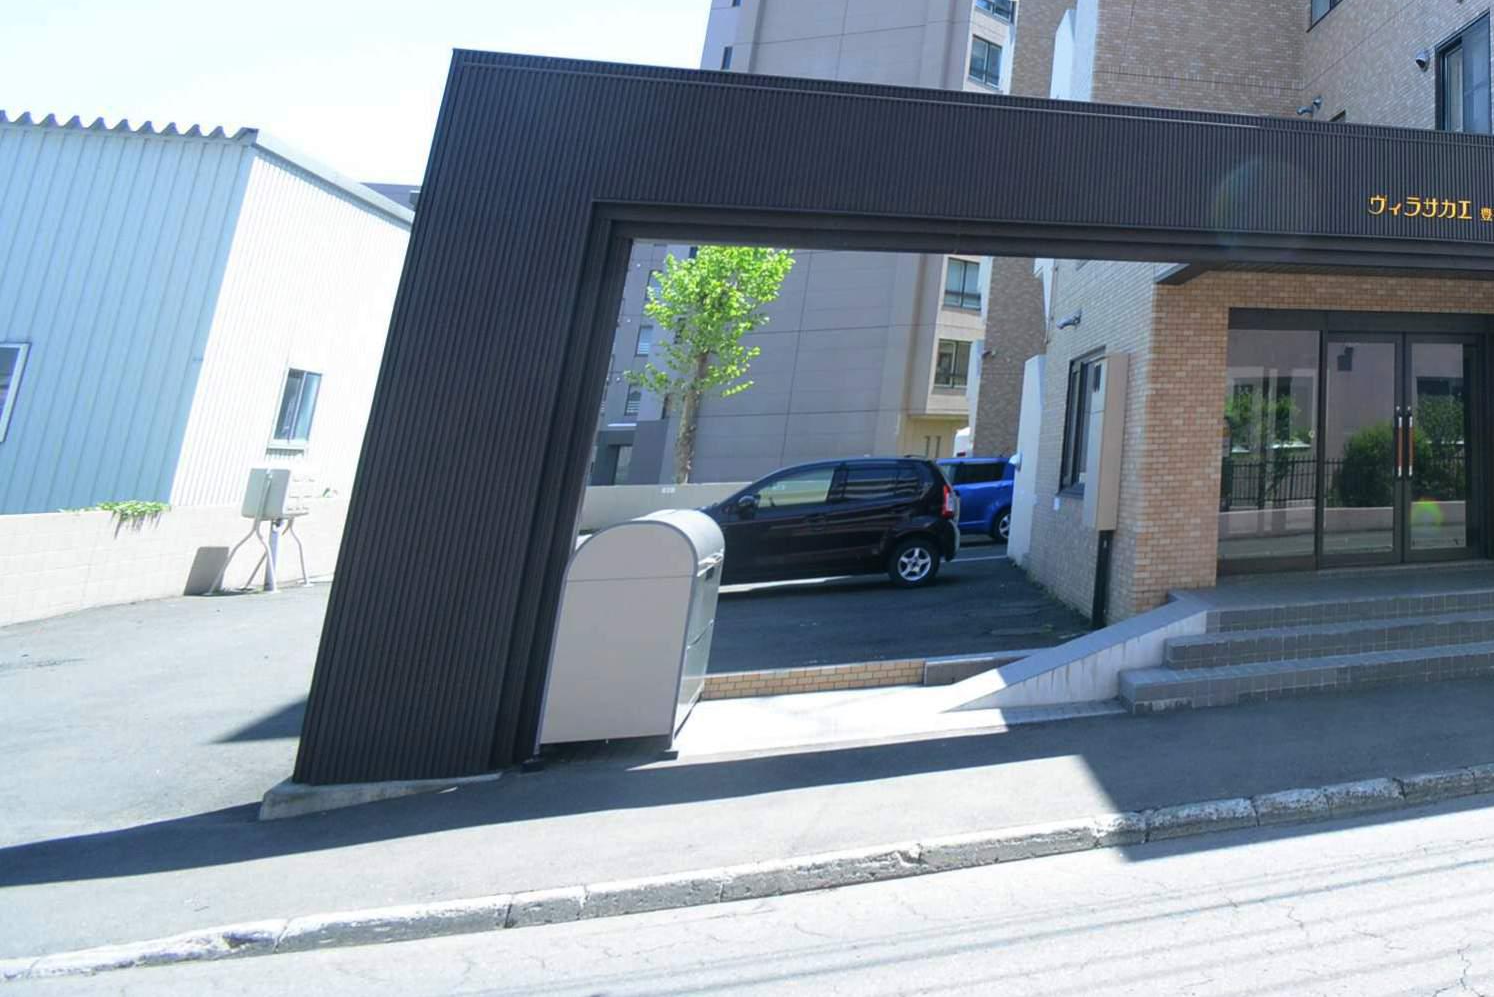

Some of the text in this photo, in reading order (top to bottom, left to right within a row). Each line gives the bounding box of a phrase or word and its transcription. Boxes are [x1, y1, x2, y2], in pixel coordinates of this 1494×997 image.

[1367, 194, 1473, 220] ヴィラサカエ
